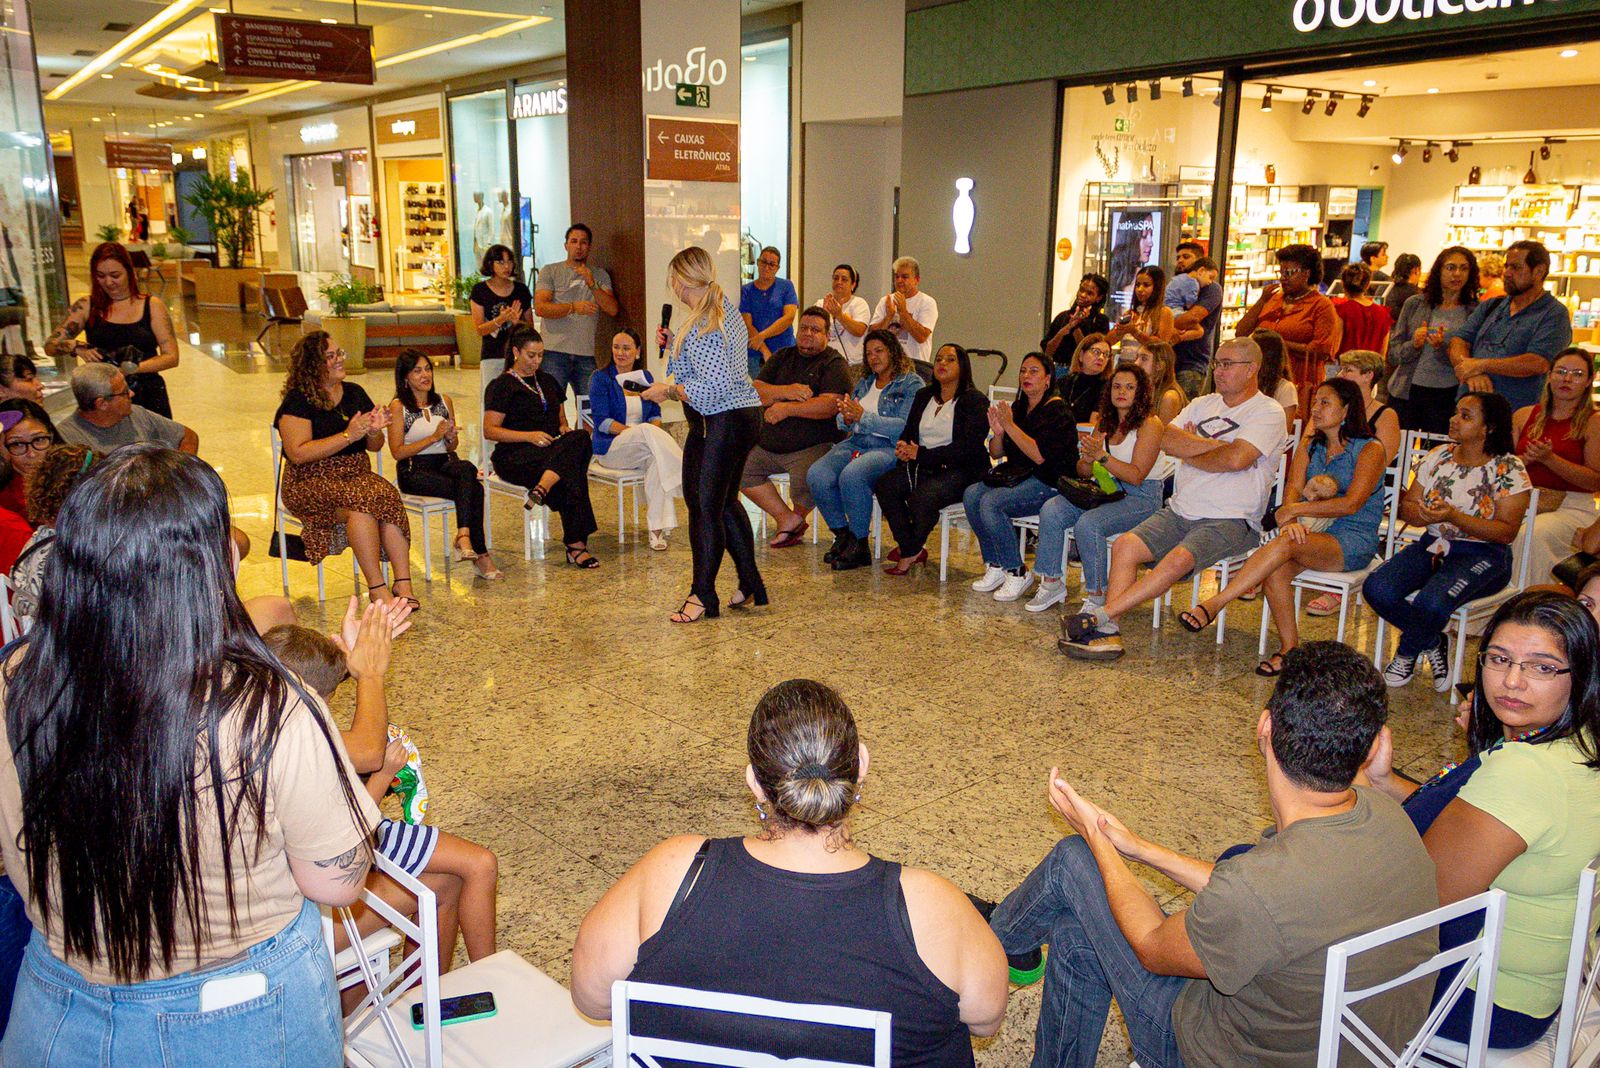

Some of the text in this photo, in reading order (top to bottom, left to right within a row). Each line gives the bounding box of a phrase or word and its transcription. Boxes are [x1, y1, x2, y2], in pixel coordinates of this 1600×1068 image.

[245, 23, 283, 31] BANHEIROS
[247, 47, 273, 55] CINEMA
[278, 50, 312, 58] ACADEMIA
[273, 61, 316, 71] ELETRÔNICOS
[513, 88, 567, 118] ARAMIS
[674, 133, 705, 145] CAIXAS
[674, 149, 731, 162] ELETRÔNICOS
[715, 163, 731, 171] ATMs
